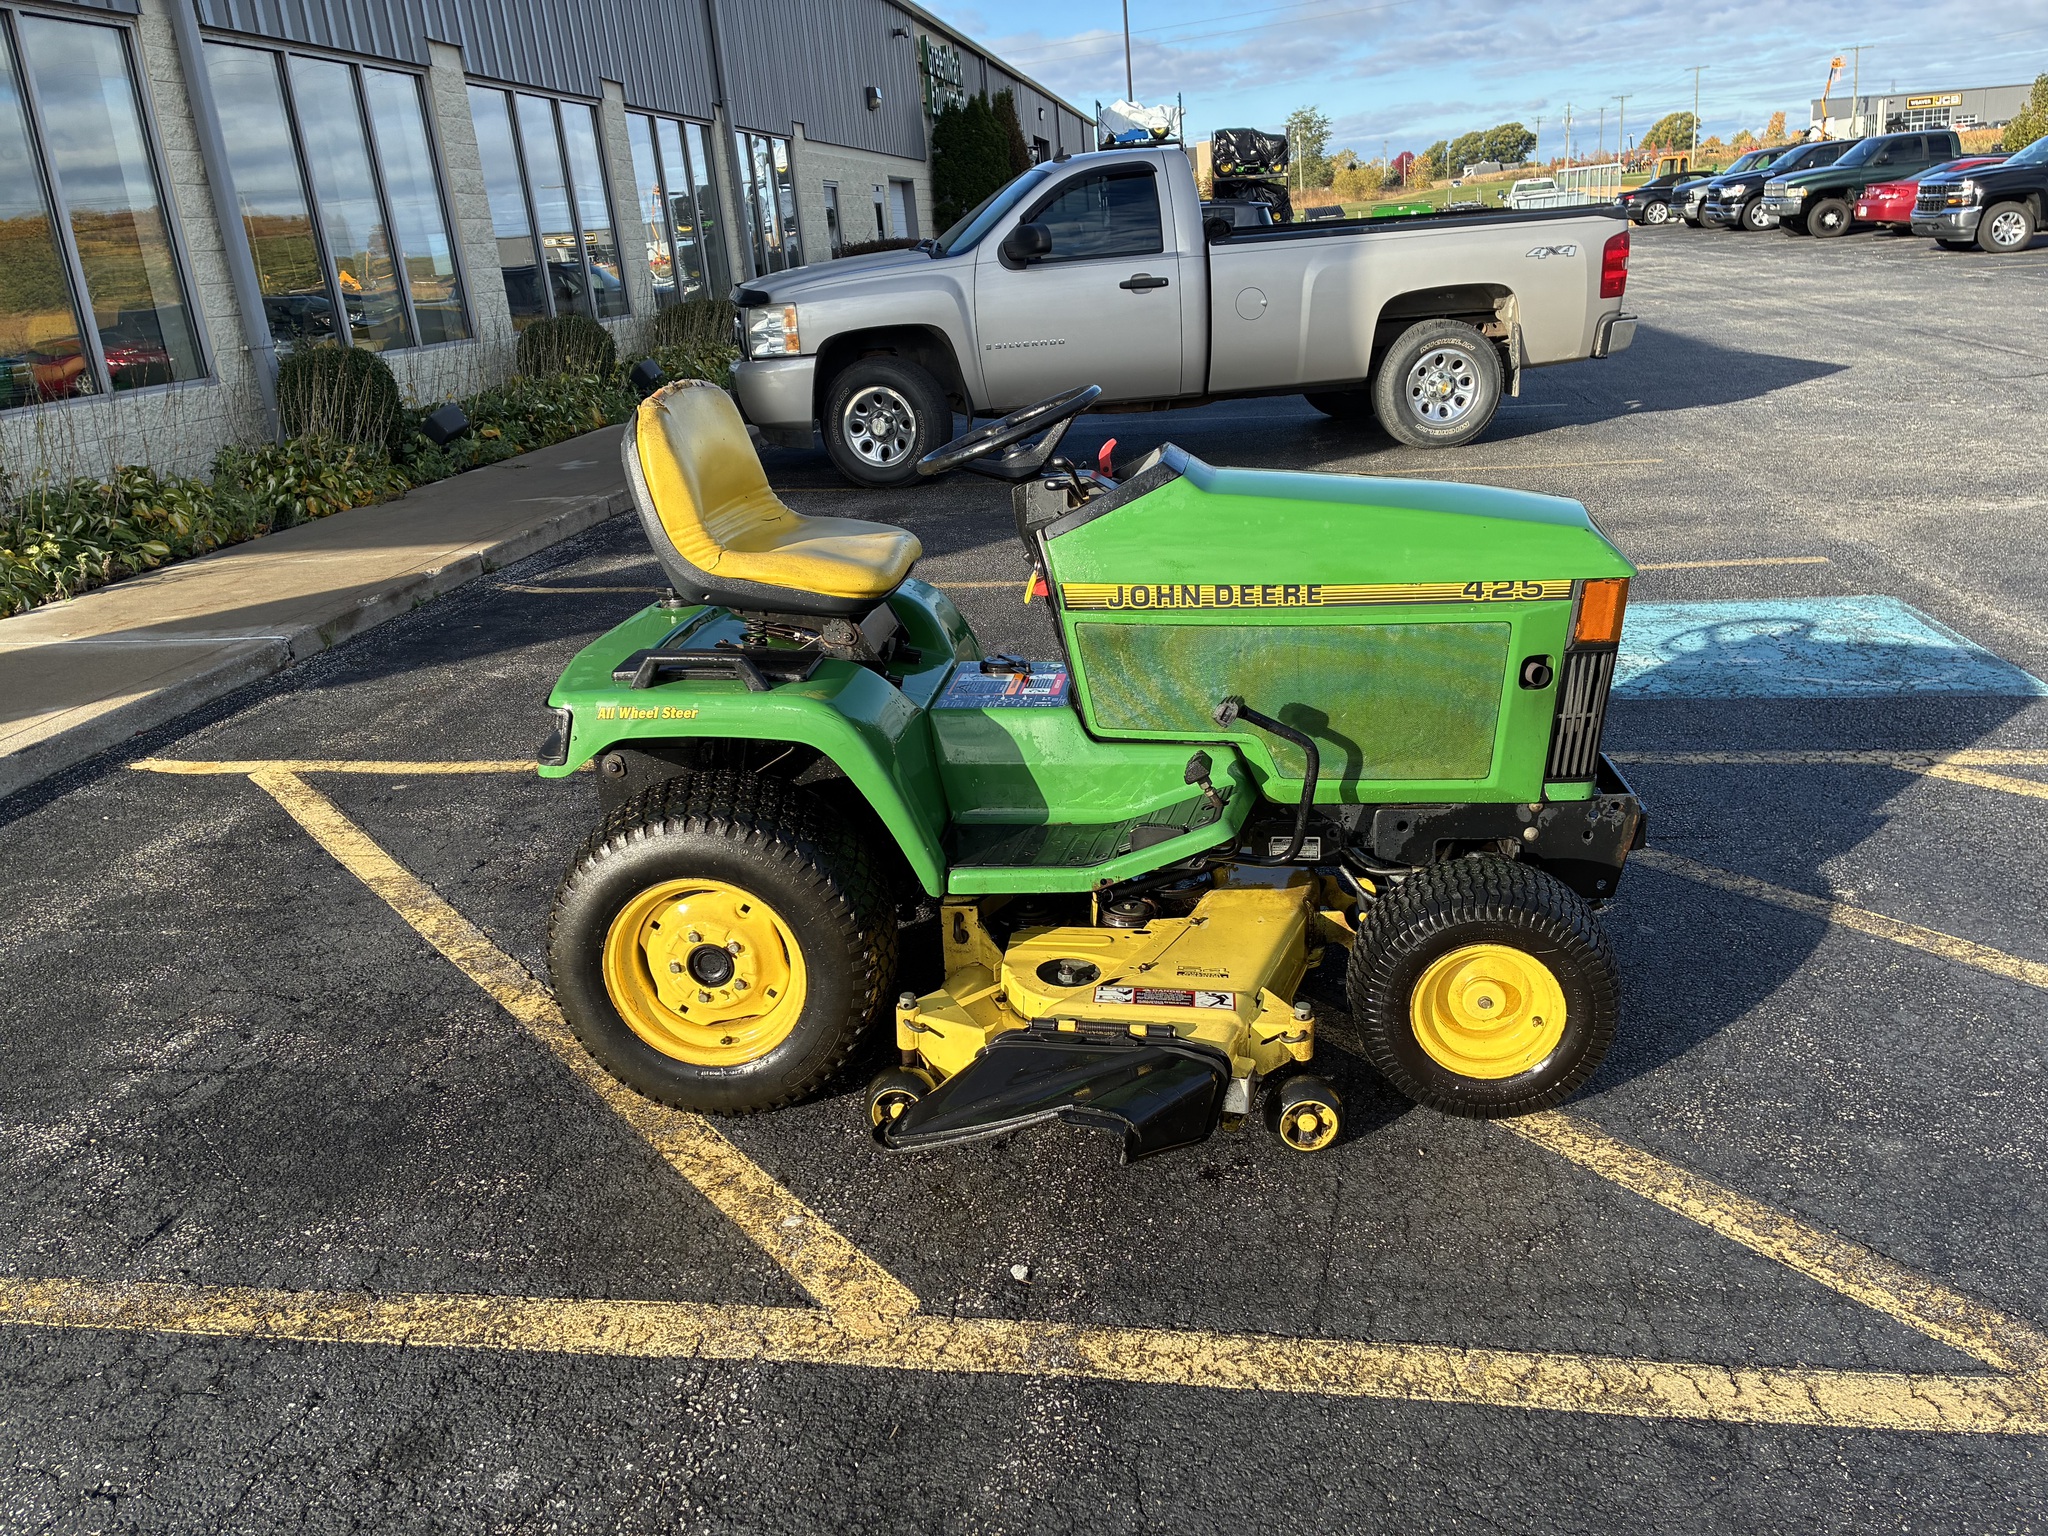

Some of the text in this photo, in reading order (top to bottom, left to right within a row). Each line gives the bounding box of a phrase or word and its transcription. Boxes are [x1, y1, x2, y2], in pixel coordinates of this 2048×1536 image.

[1935, 95, 1960, 106] JCB
[995, 338, 1066, 350] SILVERADO
[1420, 338, 1475, 353] MICHELIN
[832, 387, 850, 444] MICHELIN
[1415, 421, 1470, 436] MICHELIN
[907, 410, 925, 468] MICHELIN
[1106, 584, 1324, 609] JOHN DEERE
[1461, 581, 1544, 600] 425
[597, 706, 699, 720] All Wheel Steer
